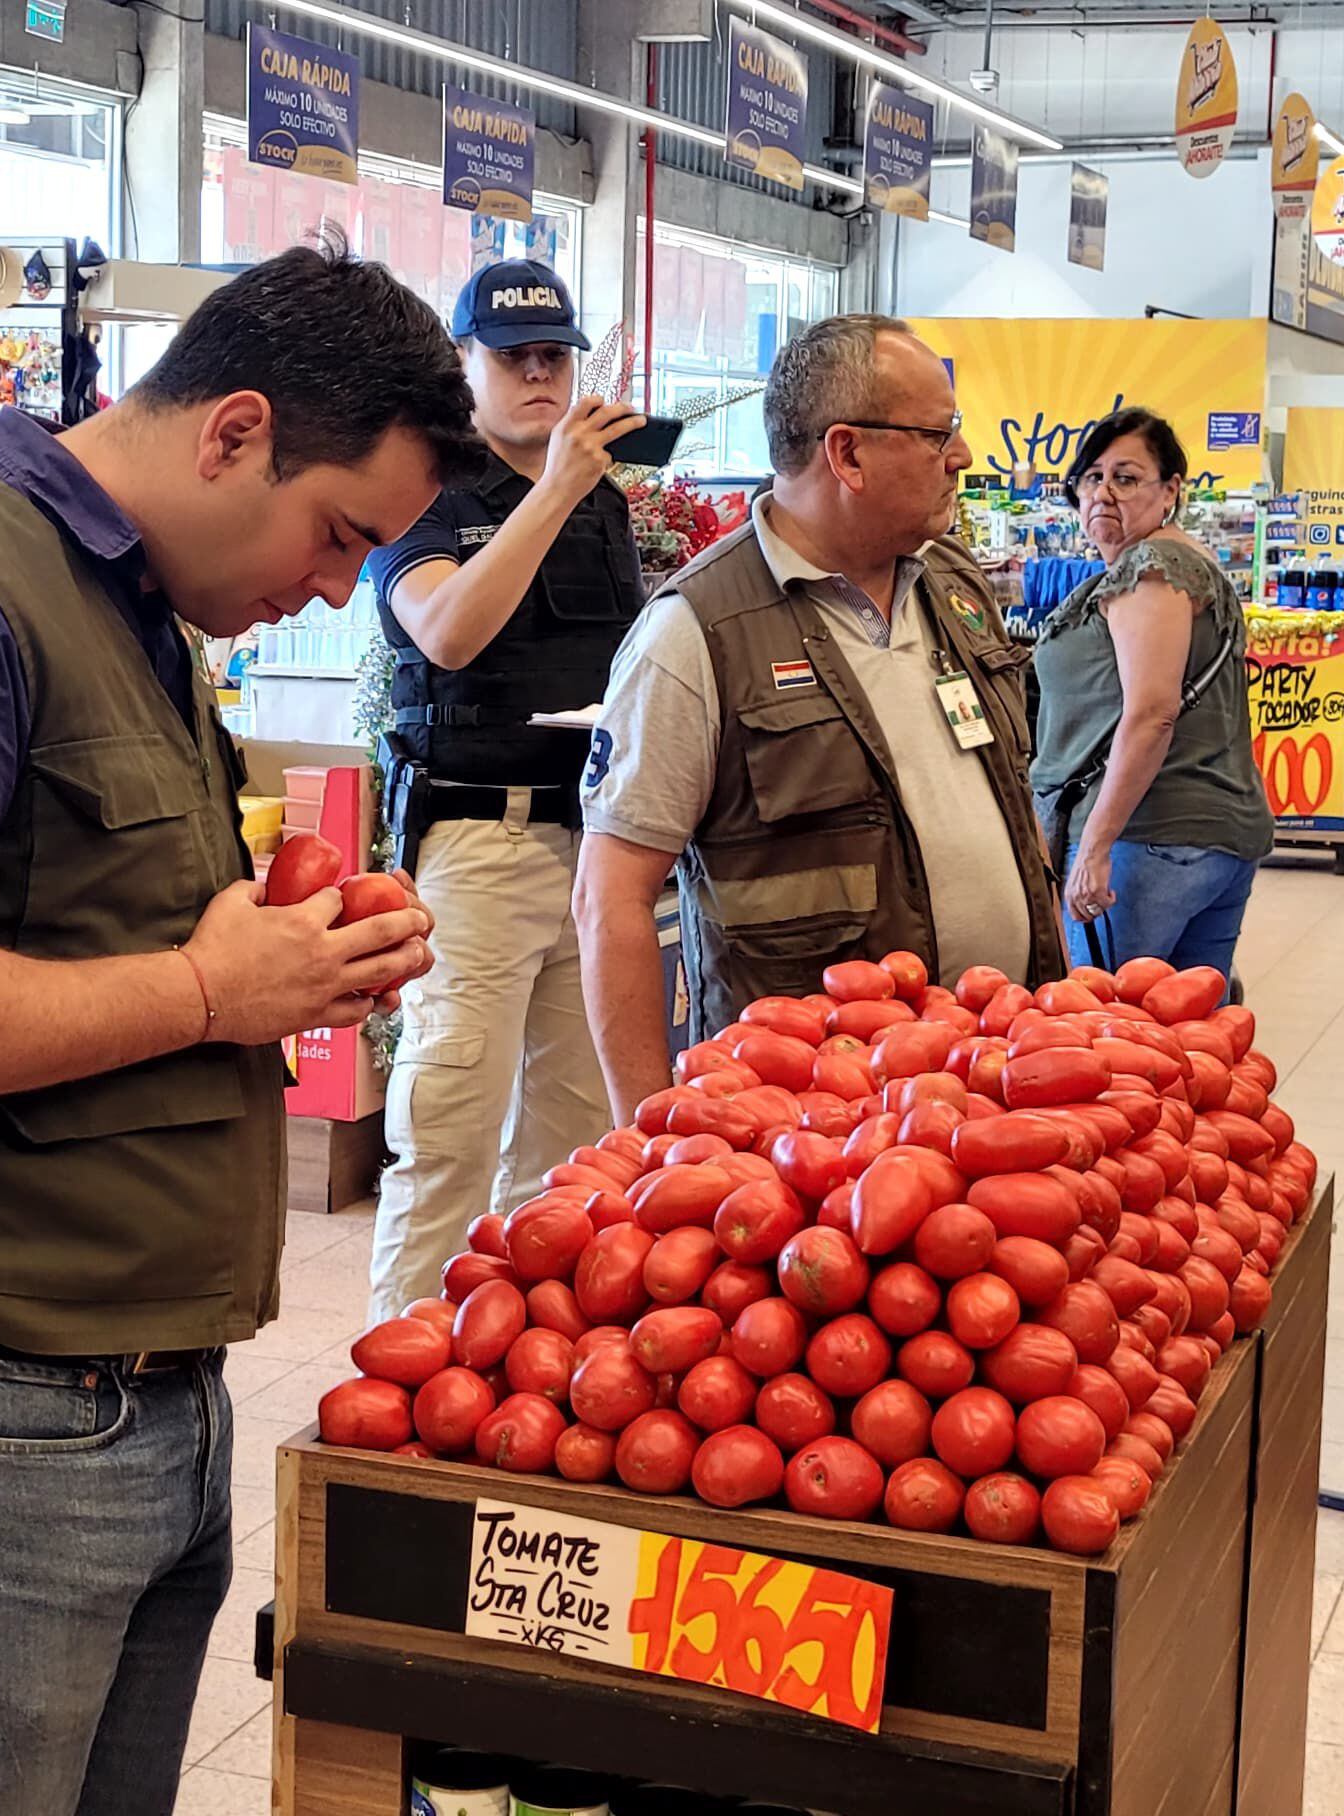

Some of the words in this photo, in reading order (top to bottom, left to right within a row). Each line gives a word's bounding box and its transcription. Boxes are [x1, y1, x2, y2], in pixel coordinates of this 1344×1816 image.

[260, 47, 299, 81] CAJA
[301, 55, 351, 97] RÁPIDA
[264, 85, 298, 109] MÁXIMO
[299, 92, 313, 113] 10
[279, 110, 302, 130] SOLO
[302, 117, 337, 138] EFECTIVO
[452, 104, 483, 135] CAJA
[259, 142, 296, 162] STOCK
[482, 143, 494, 162] 10
[1246, 656, 1317, 698] PARTY
[1257, 696, 1321, 726] TOCADOR
[476, 1511, 602, 1577] TOMATE
[470, 1555, 525, 1615] STA
[536, 1570, 611, 1632] CRUZ
[627, 1535, 896, 1736] 15650
